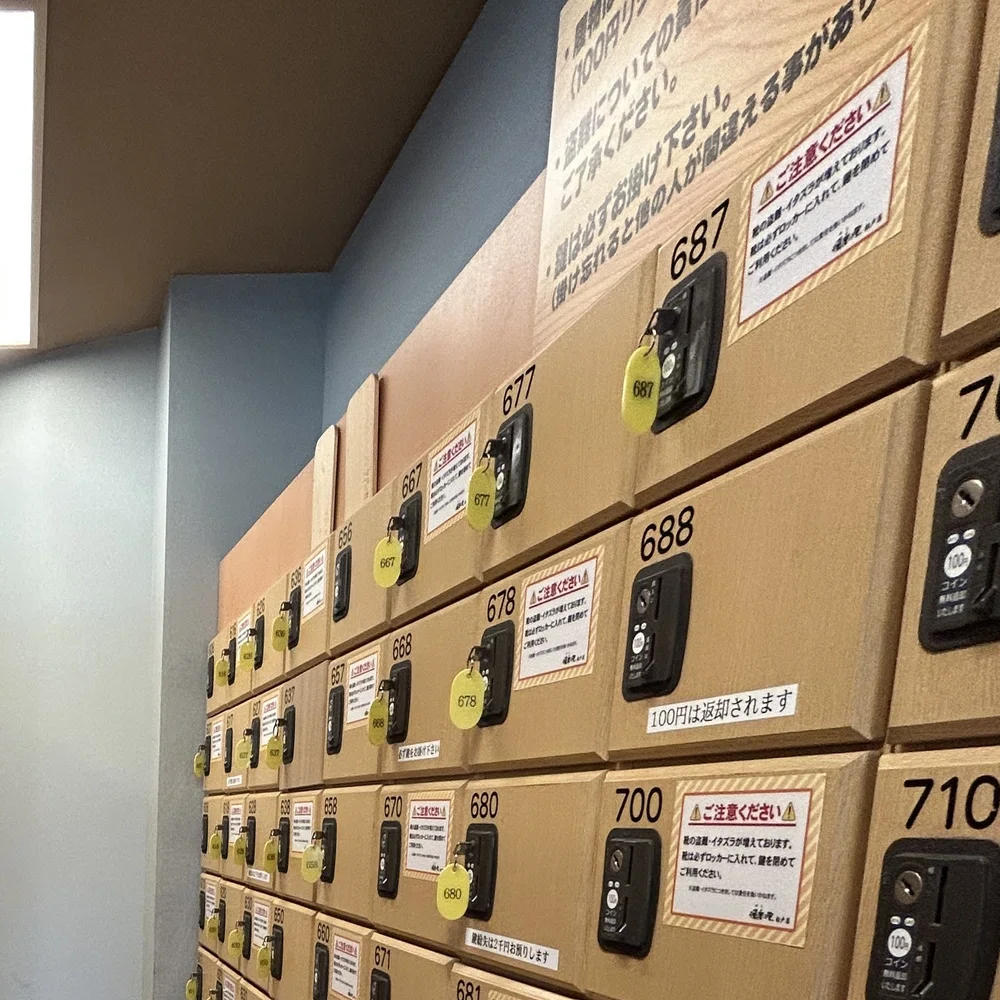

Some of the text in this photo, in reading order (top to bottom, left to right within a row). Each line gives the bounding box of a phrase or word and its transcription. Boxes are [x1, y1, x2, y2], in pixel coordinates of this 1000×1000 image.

[564, 0, 708, 169] 盗難についての責
[561, 68, 677, 210] ご了承ください。
[776, 100, 872, 190] ご注意ください
[671, 198, 729, 280] 687
[503, 365, 536, 415] 677
[633, 380, 654, 398] 687
[402, 462, 423, 498] 667
[474, 493, 490, 506] 677
[338, 522, 352, 549] 656
[640, 505, 695, 562] 688
[380, 557, 395, 568] 667
[537, 575, 581, 601] ご注意ください
[487, 586, 516, 622] 678
[392, 632, 412, 660] 668
[331, 663, 345, 686] 657
[458, 695, 477, 707] 678
[651, 689, 793, 728] 100円は返却されます
[372, 718, 385, 728] 668
[324, 796, 338, 815] 658
[384, 796, 402, 817] 670
[470, 792, 499, 819] 680
[616, 787, 663, 823] 700
[703, 803, 781, 821] ご注意ください
[903, 775, 1000, 830] 710
[443, 888, 462, 900] 680
[317, 922, 330, 943] 660
[375, 946, 391, 970] 671
[884, 958, 908, 968] コイン
